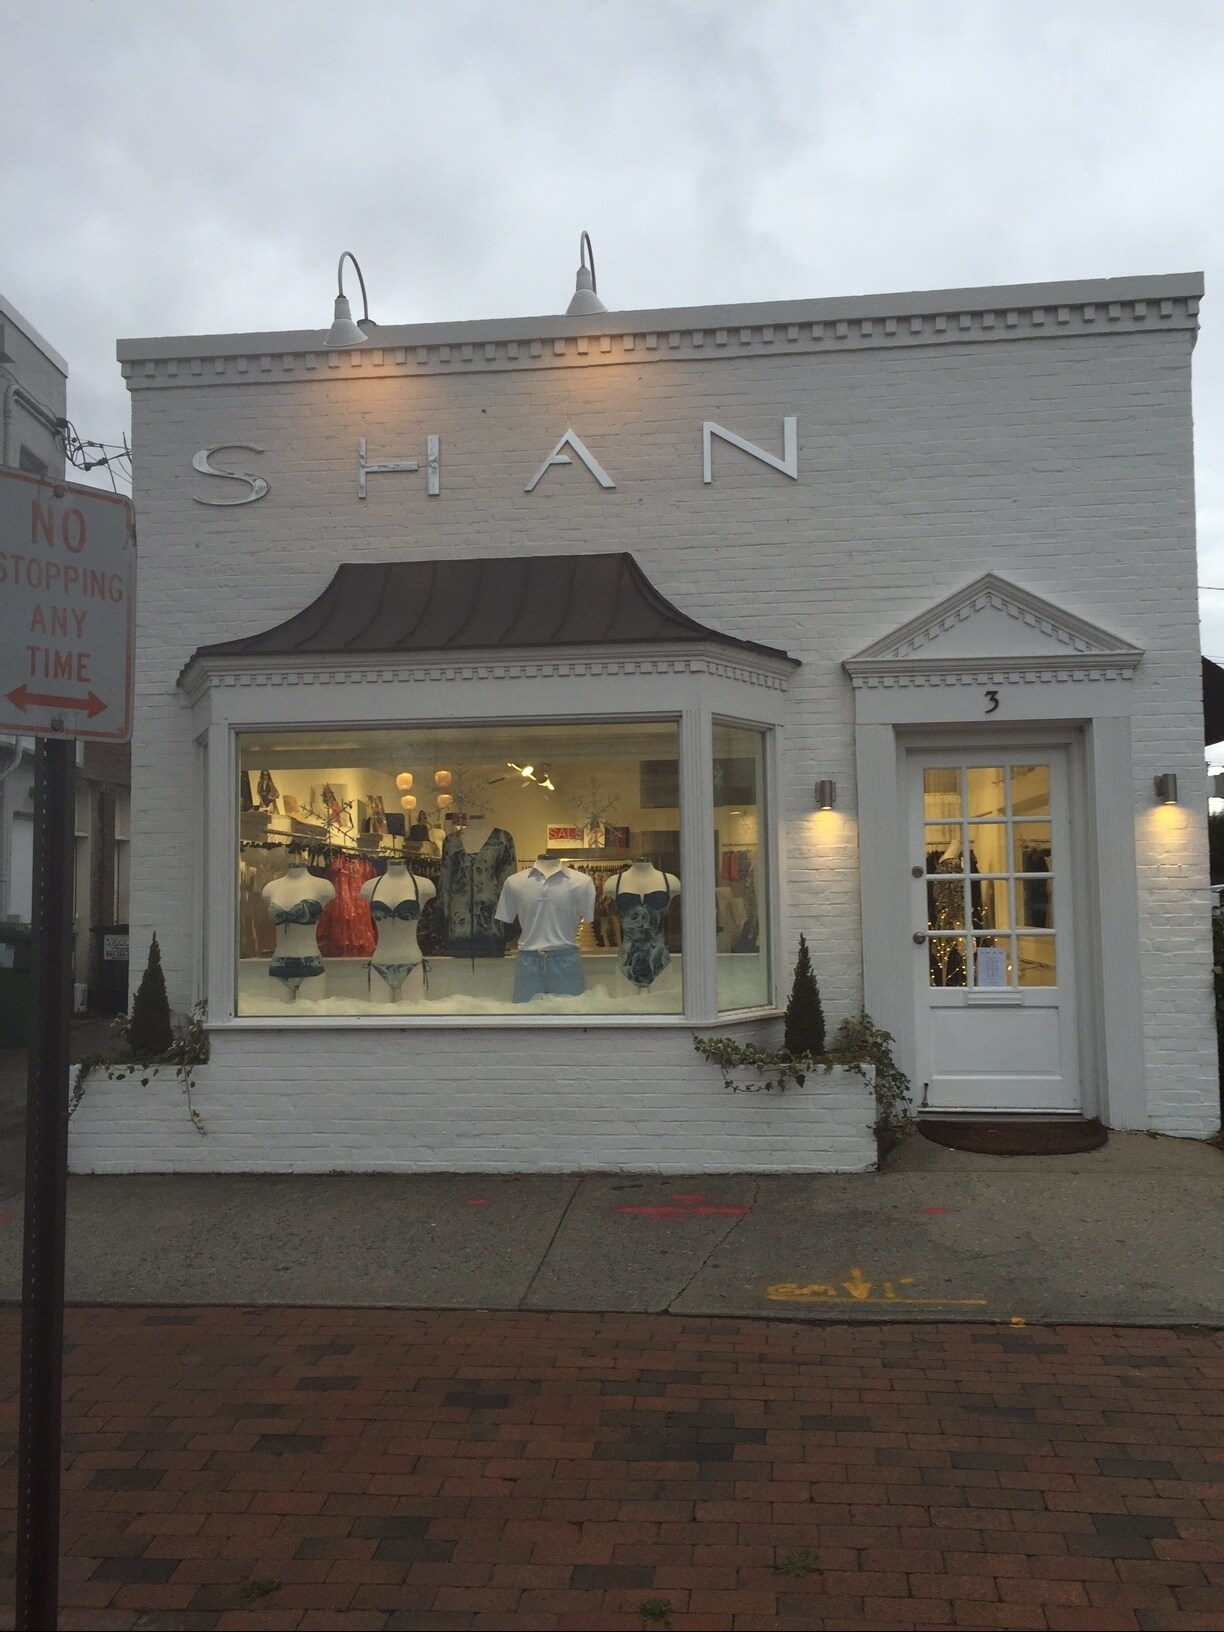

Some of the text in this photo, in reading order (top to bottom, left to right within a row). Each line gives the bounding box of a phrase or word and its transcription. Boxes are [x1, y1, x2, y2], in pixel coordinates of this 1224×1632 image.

[192, 416, 799, 506] SHAN
[31, 499, 87, 554] NO
[30, 602, 88, 639] ANY
[27, 645, 91, 683] TIME
[984, 690, 999, 714] 3
